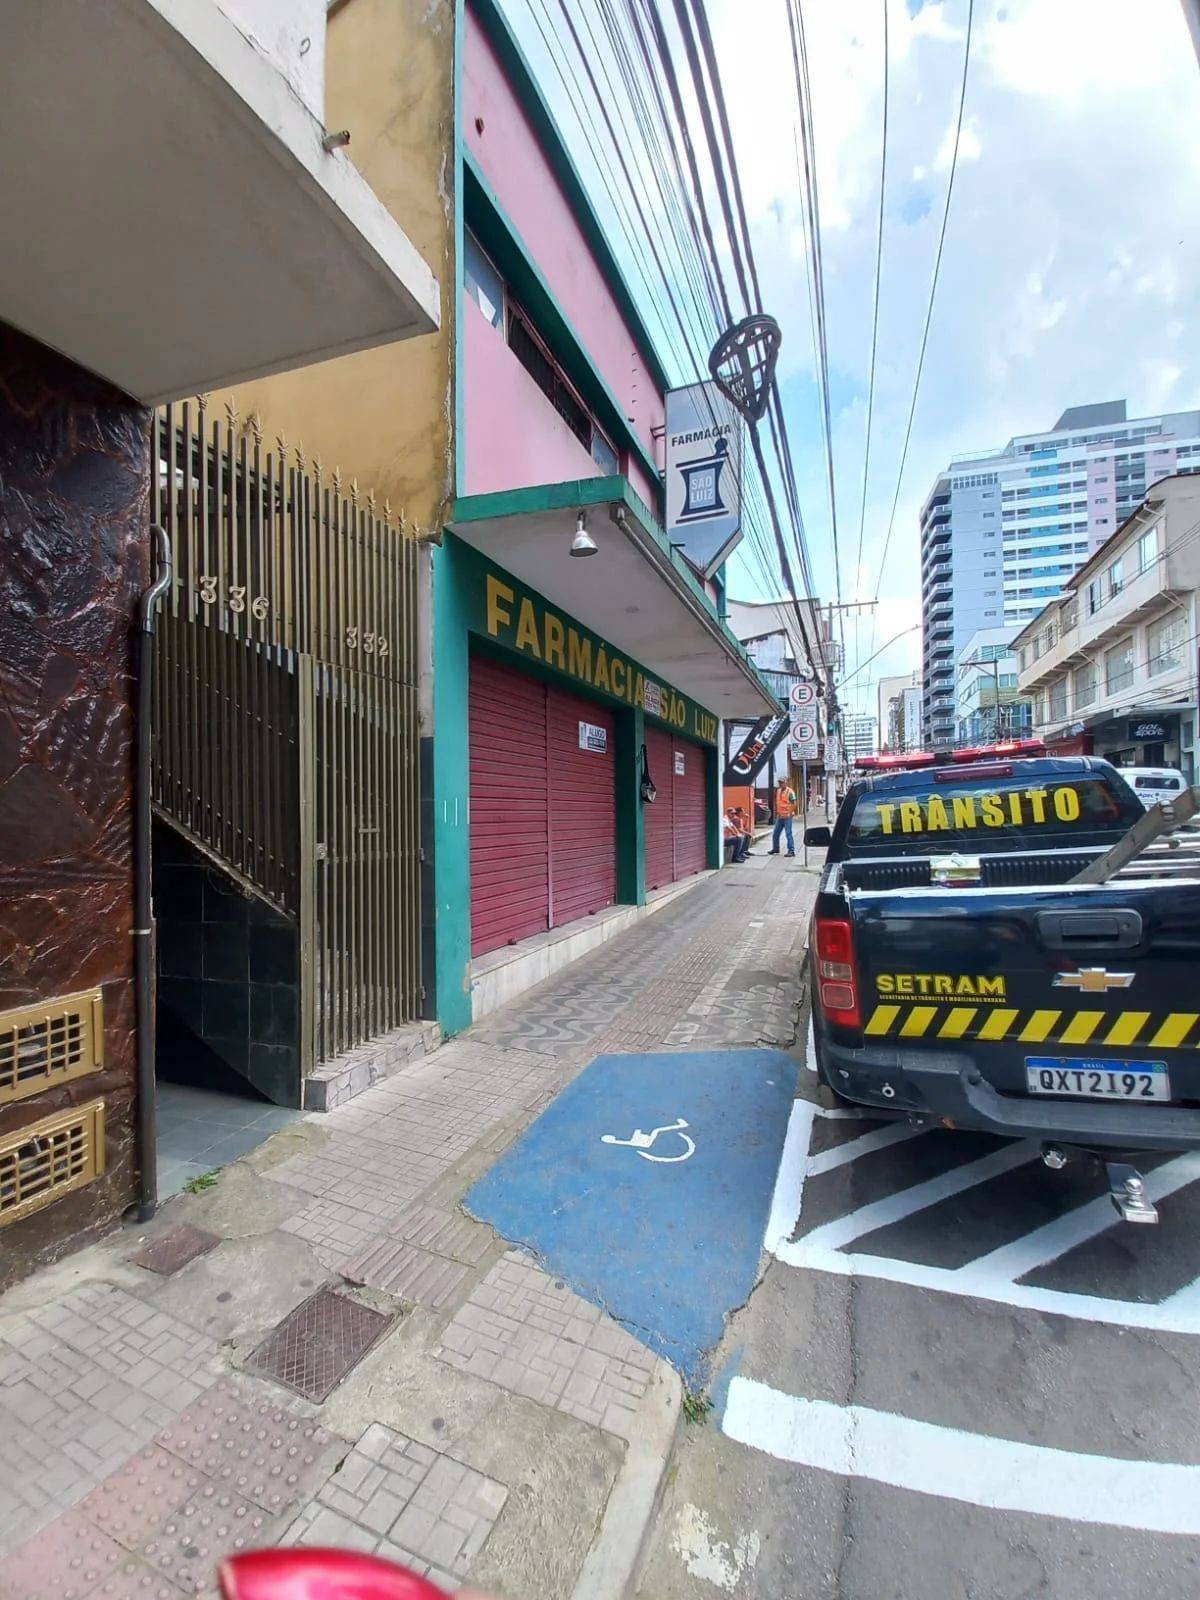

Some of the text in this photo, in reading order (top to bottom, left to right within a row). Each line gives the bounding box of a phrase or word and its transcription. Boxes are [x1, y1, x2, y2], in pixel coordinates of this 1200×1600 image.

[690, 488, 713, 503] LUIZ
[200, 576, 269, 621] 336
[346, 626, 389, 656] 332
[487, 574, 646, 707] FARMÁCIA
[659, 687, 686, 728] SÃO
[695, 707, 717, 743] LUIZ
[799, 688, 807, 700] E
[799, 726, 808, 738] E
[876, 787, 1081, 835] TRÂNSITO
[876, 974, 1005, 994] SETRAM
